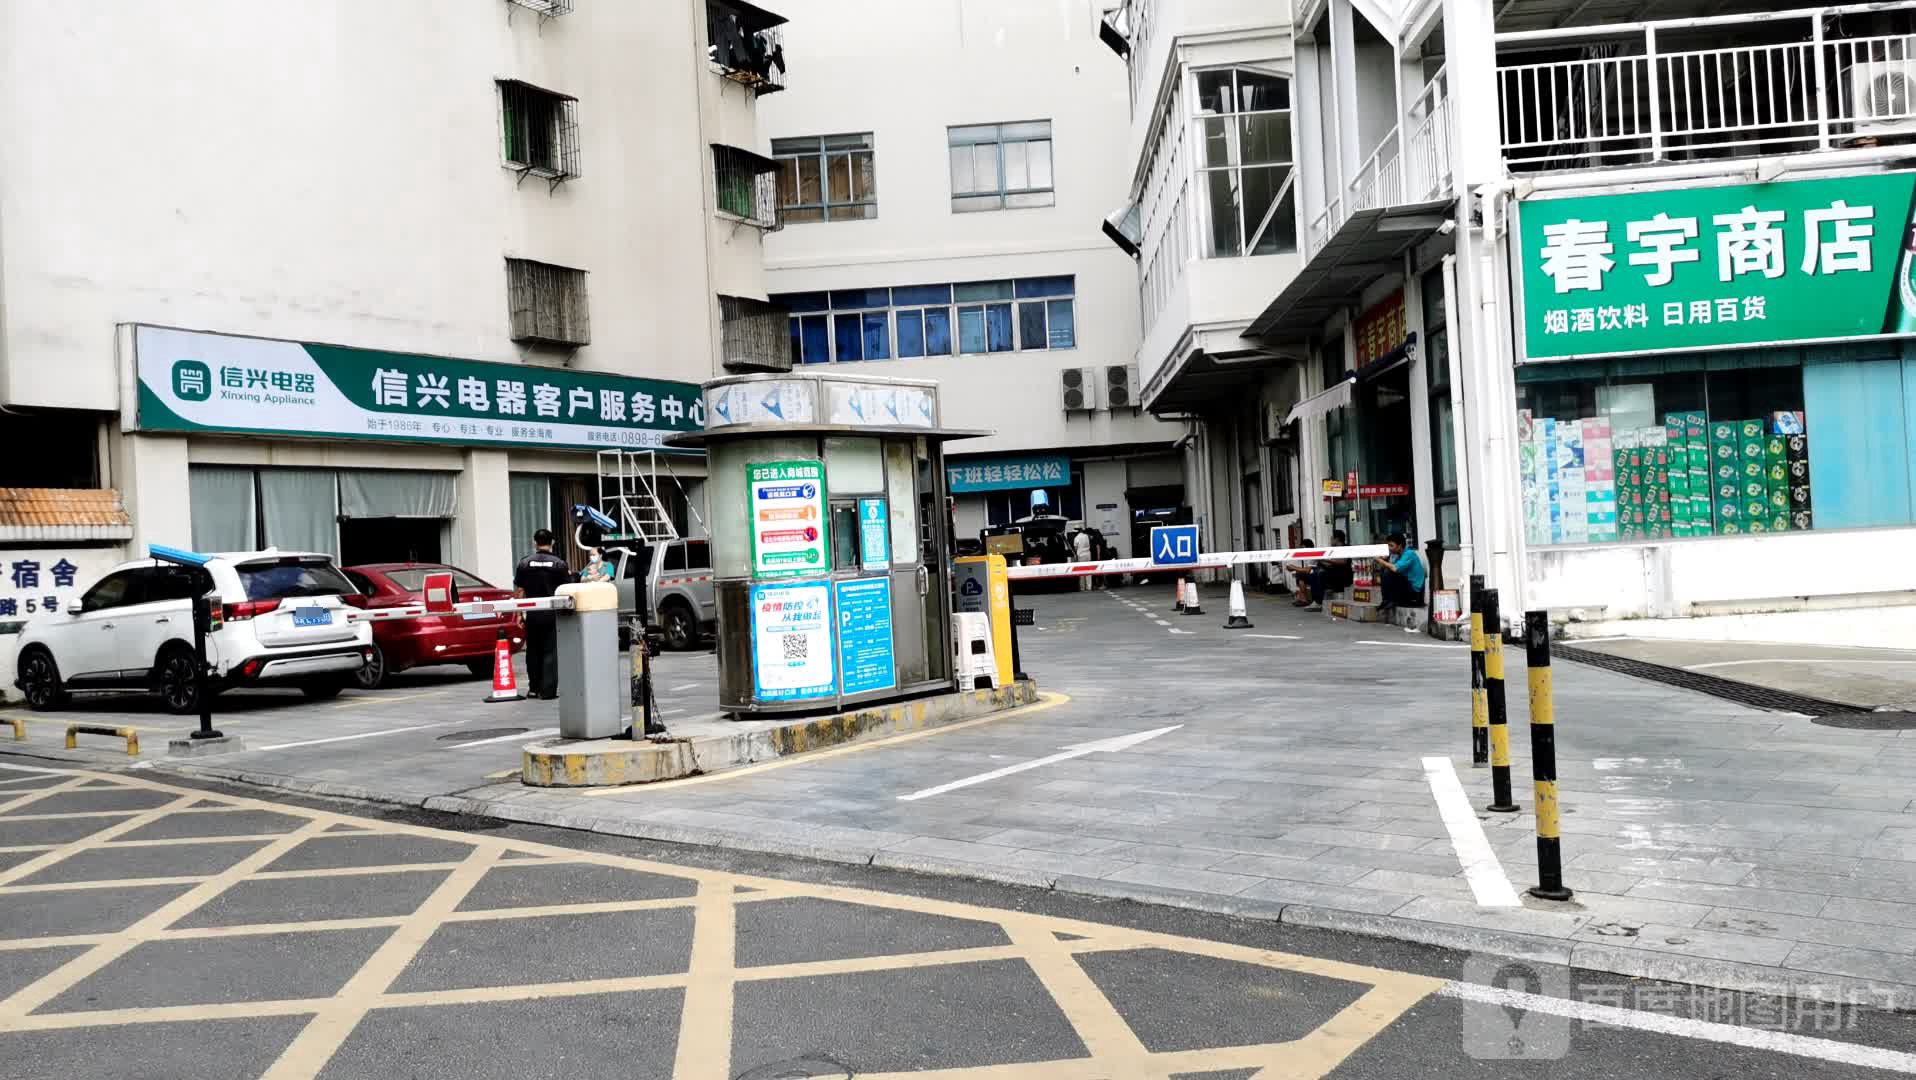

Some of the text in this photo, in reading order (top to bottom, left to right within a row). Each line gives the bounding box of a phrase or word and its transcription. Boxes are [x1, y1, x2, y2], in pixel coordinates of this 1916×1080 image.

[1540, 200, 1875, 294] 春宇商店
[1544, 296, 1767, 335] 烟酒饮料 日用百货
[220, 365, 316, 393] 信兴电器
[220, 391, 316, 405] Xinxing Appliance
[371, 368, 704, 425] 信兴电器客户服务中心
[367, 418, 422, 432] 始于1986年
[587, 431, 662, 446] 服务电话:0898-6
[947, 462, 1061, 485] 下班轻轻松松
[1158, 533, 1191, 560] 入口
[0, 558, 79, 588] 宿舍
[761, 601, 804, 613] 疫情防控
